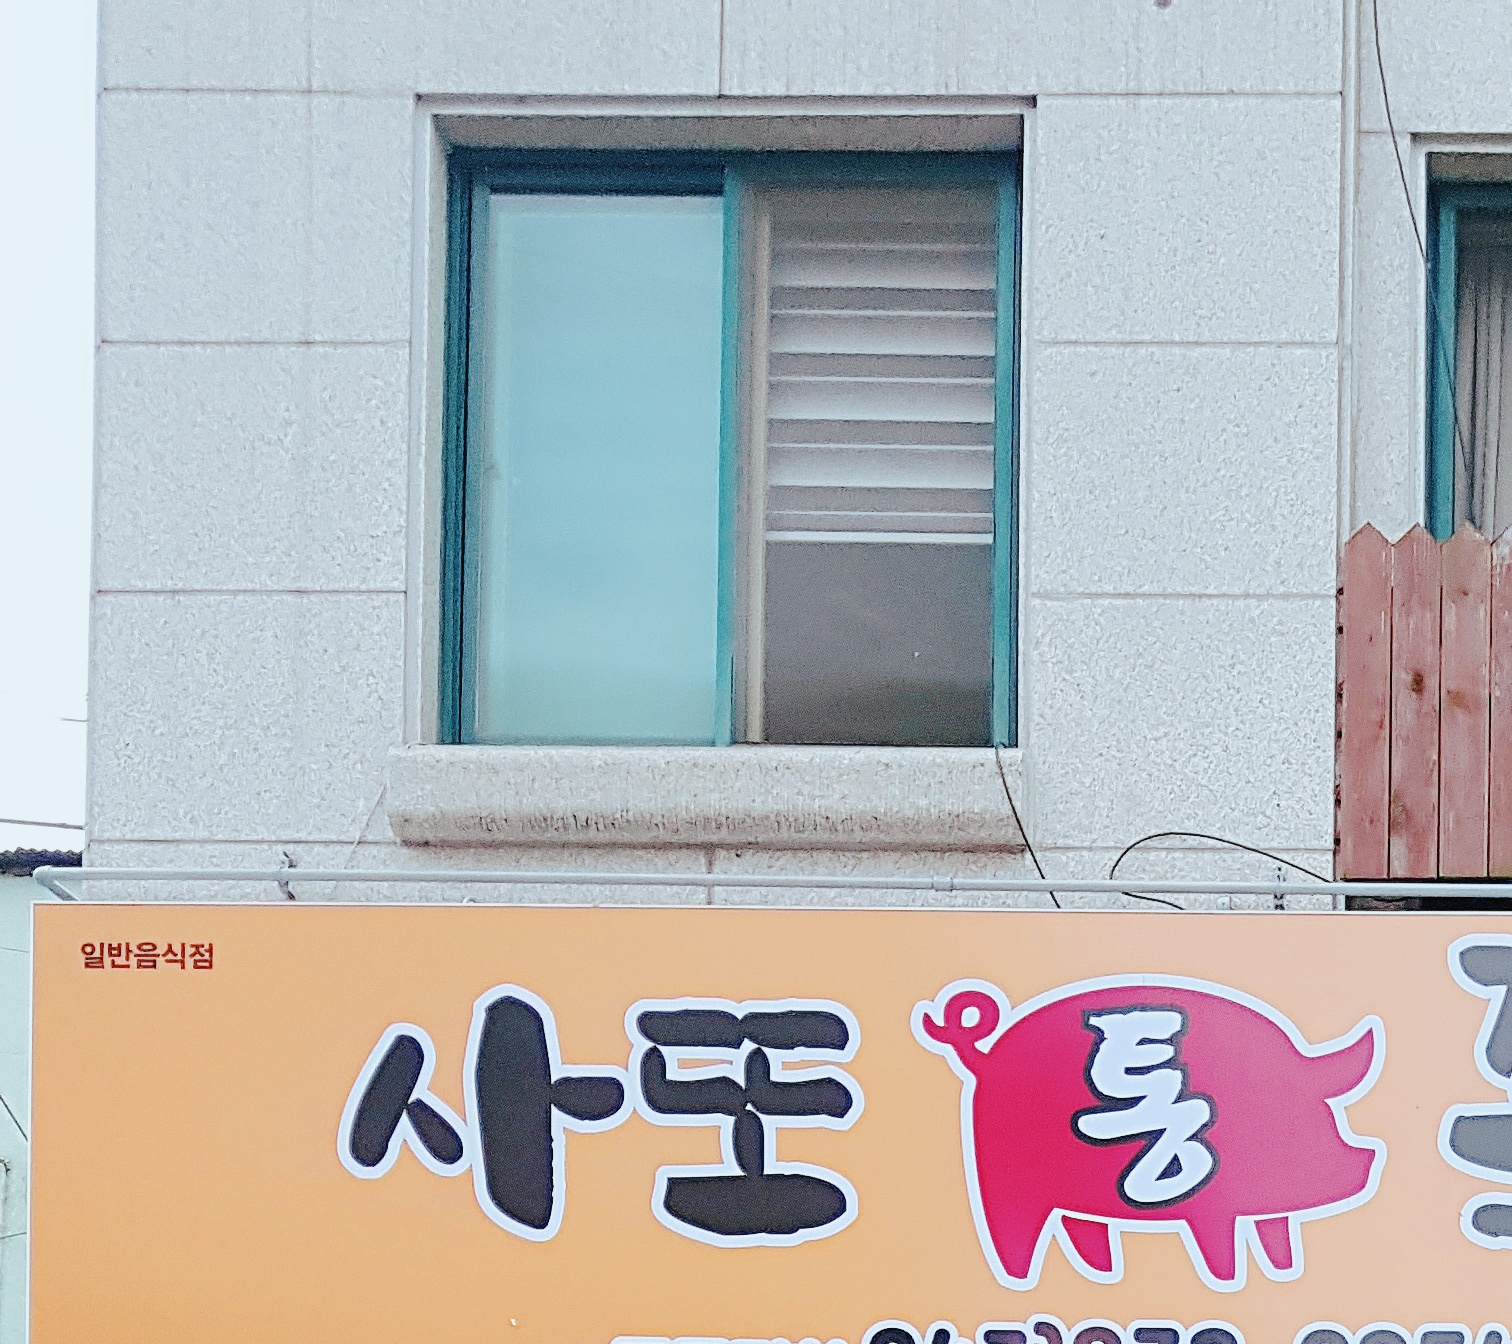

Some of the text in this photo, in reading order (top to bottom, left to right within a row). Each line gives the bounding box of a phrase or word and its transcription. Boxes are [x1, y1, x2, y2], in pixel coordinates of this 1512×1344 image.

[80, 941, 214, 971] 일반음식점
[345, 992, 857, 1240] 사또
[1074, 1006, 1219, 1207] 통
